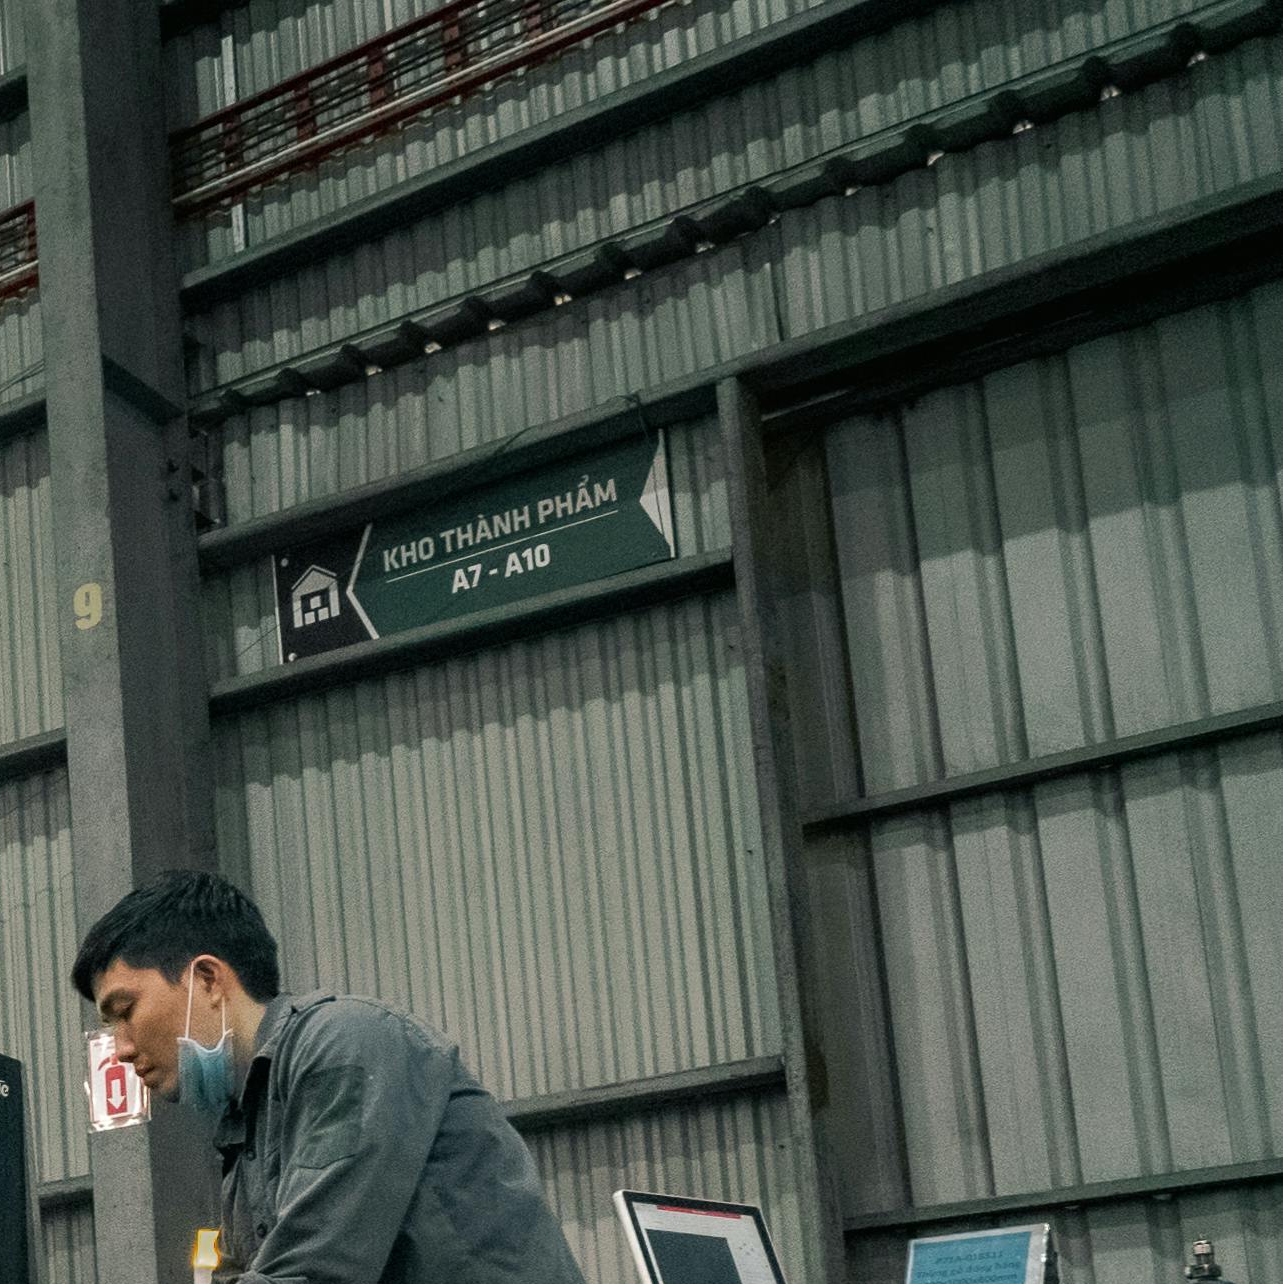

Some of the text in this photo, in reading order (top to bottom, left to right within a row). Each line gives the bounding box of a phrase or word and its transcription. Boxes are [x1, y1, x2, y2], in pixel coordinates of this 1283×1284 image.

[383, 474, 618, 572] KHO THÀNH PHẨM
[451, 562, 482, 594] A7
[504, 543, 551, 579] A10
[74, 582, 103, 631] 9
